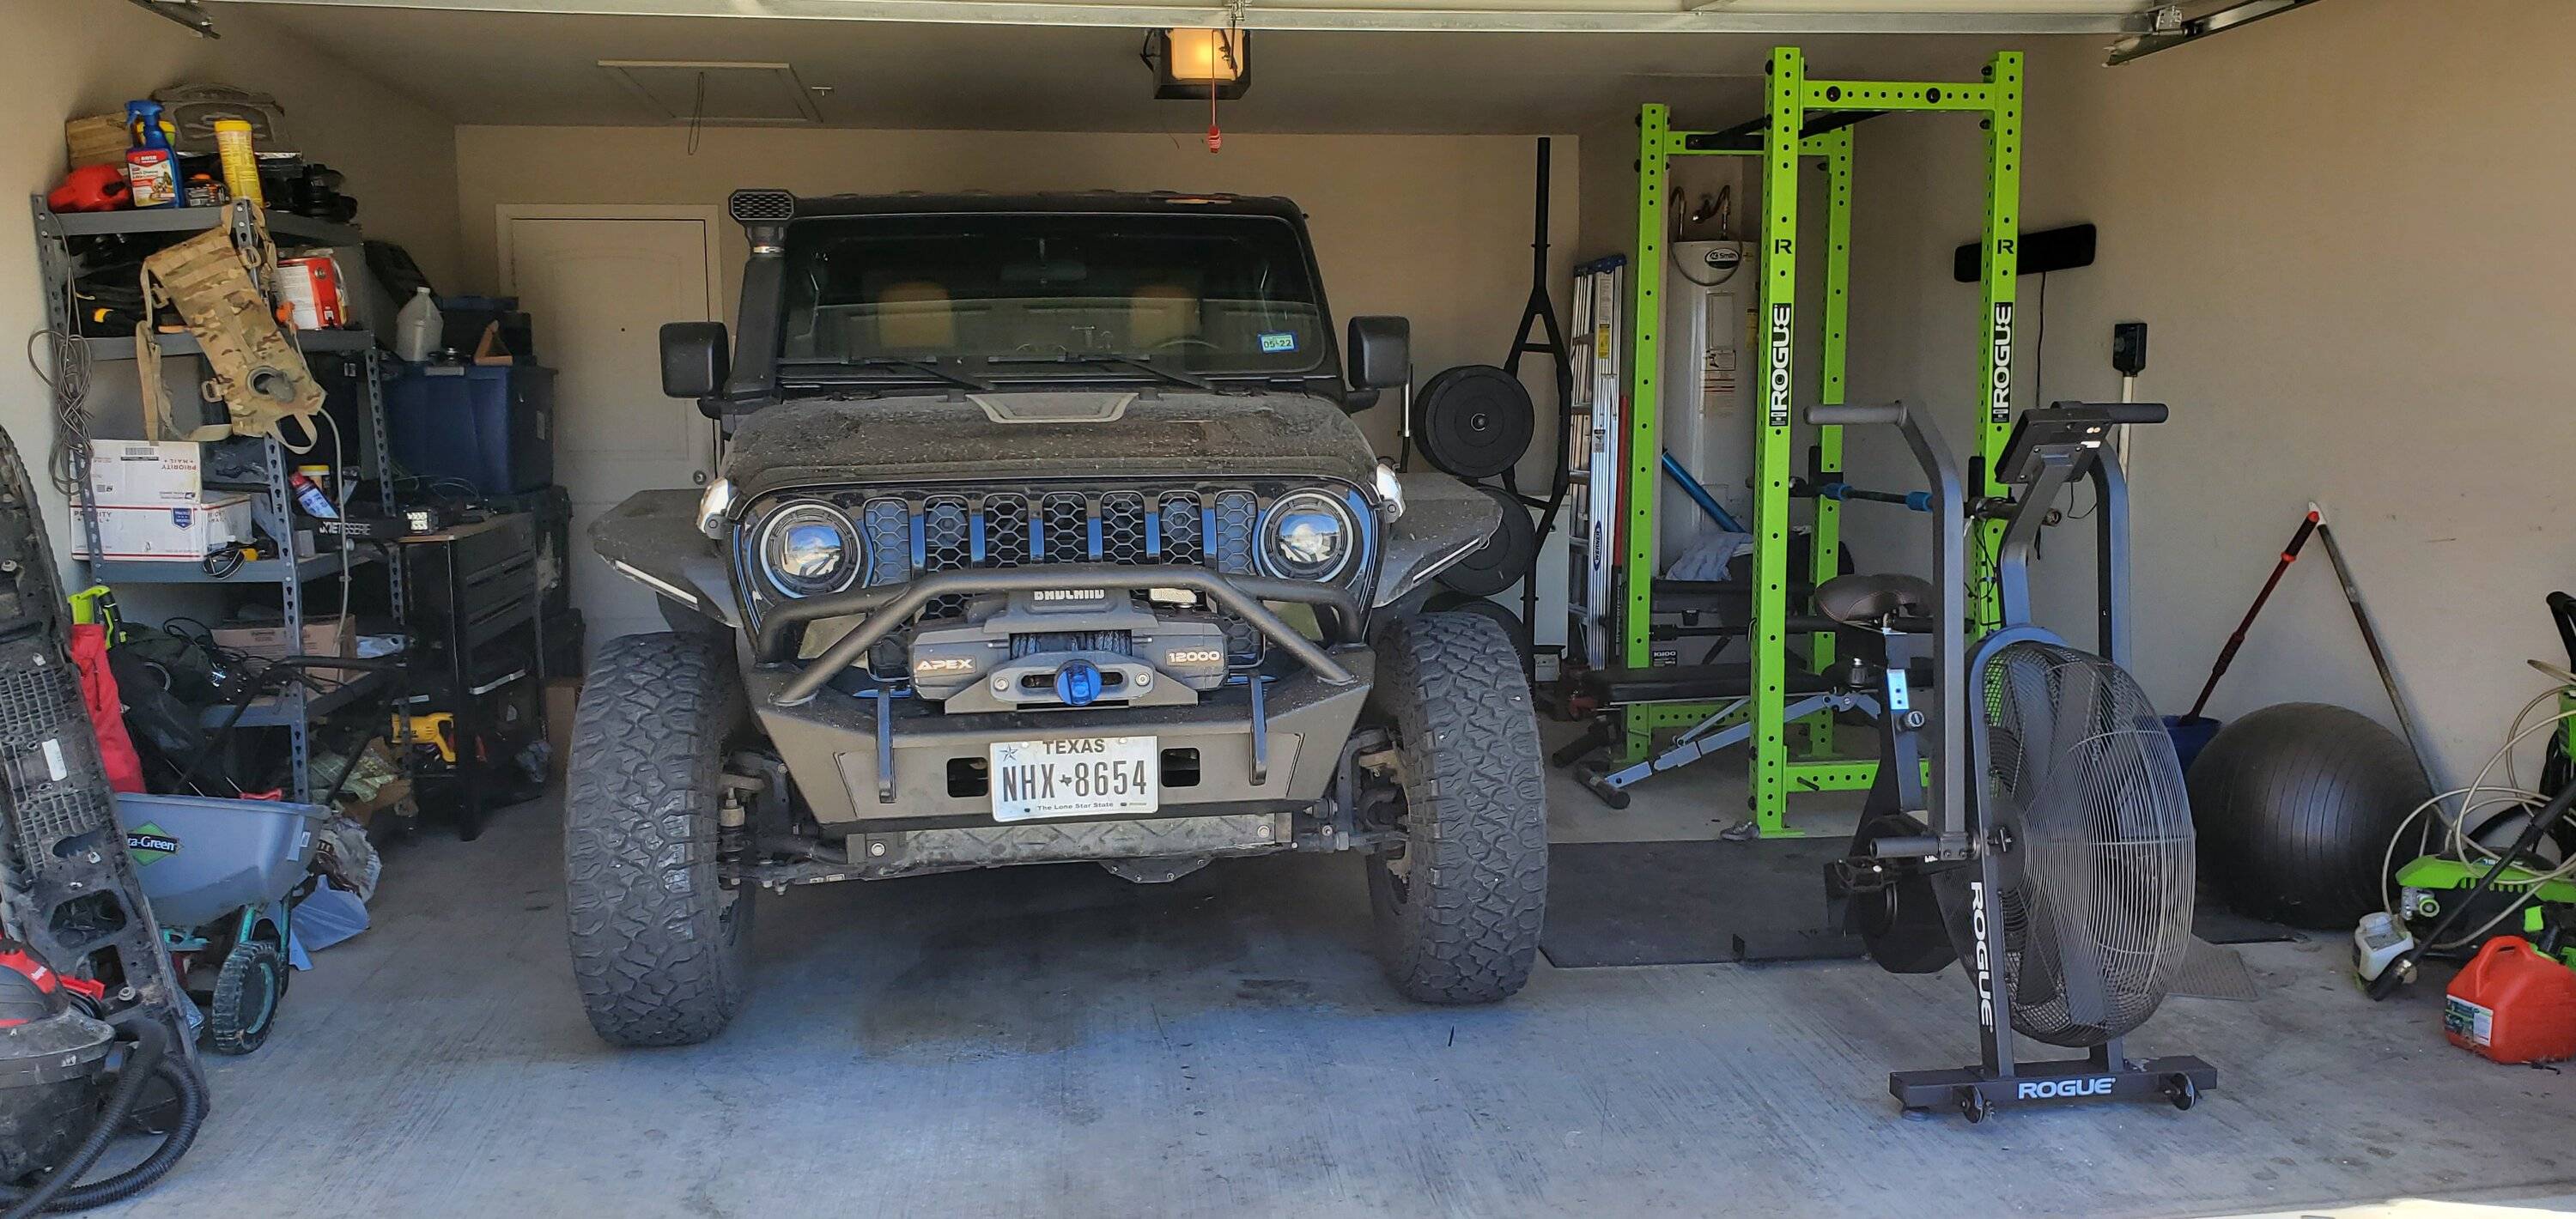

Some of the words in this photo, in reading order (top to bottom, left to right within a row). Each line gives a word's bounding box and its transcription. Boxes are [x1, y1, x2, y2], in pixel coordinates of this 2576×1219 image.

[1771, 306, 1790, 411] ROGUE
[1993, 305, 2012, 409] ROGUE
[916, 658, 974, 670] APEX
[1169, 651, 1220, 663] 12000
[1042, 738, 1105, 755] TEXAS
[1971, 882, 1993, 1027] ROGUE
[2018, 1077, 2112, 1100] ROGUE
